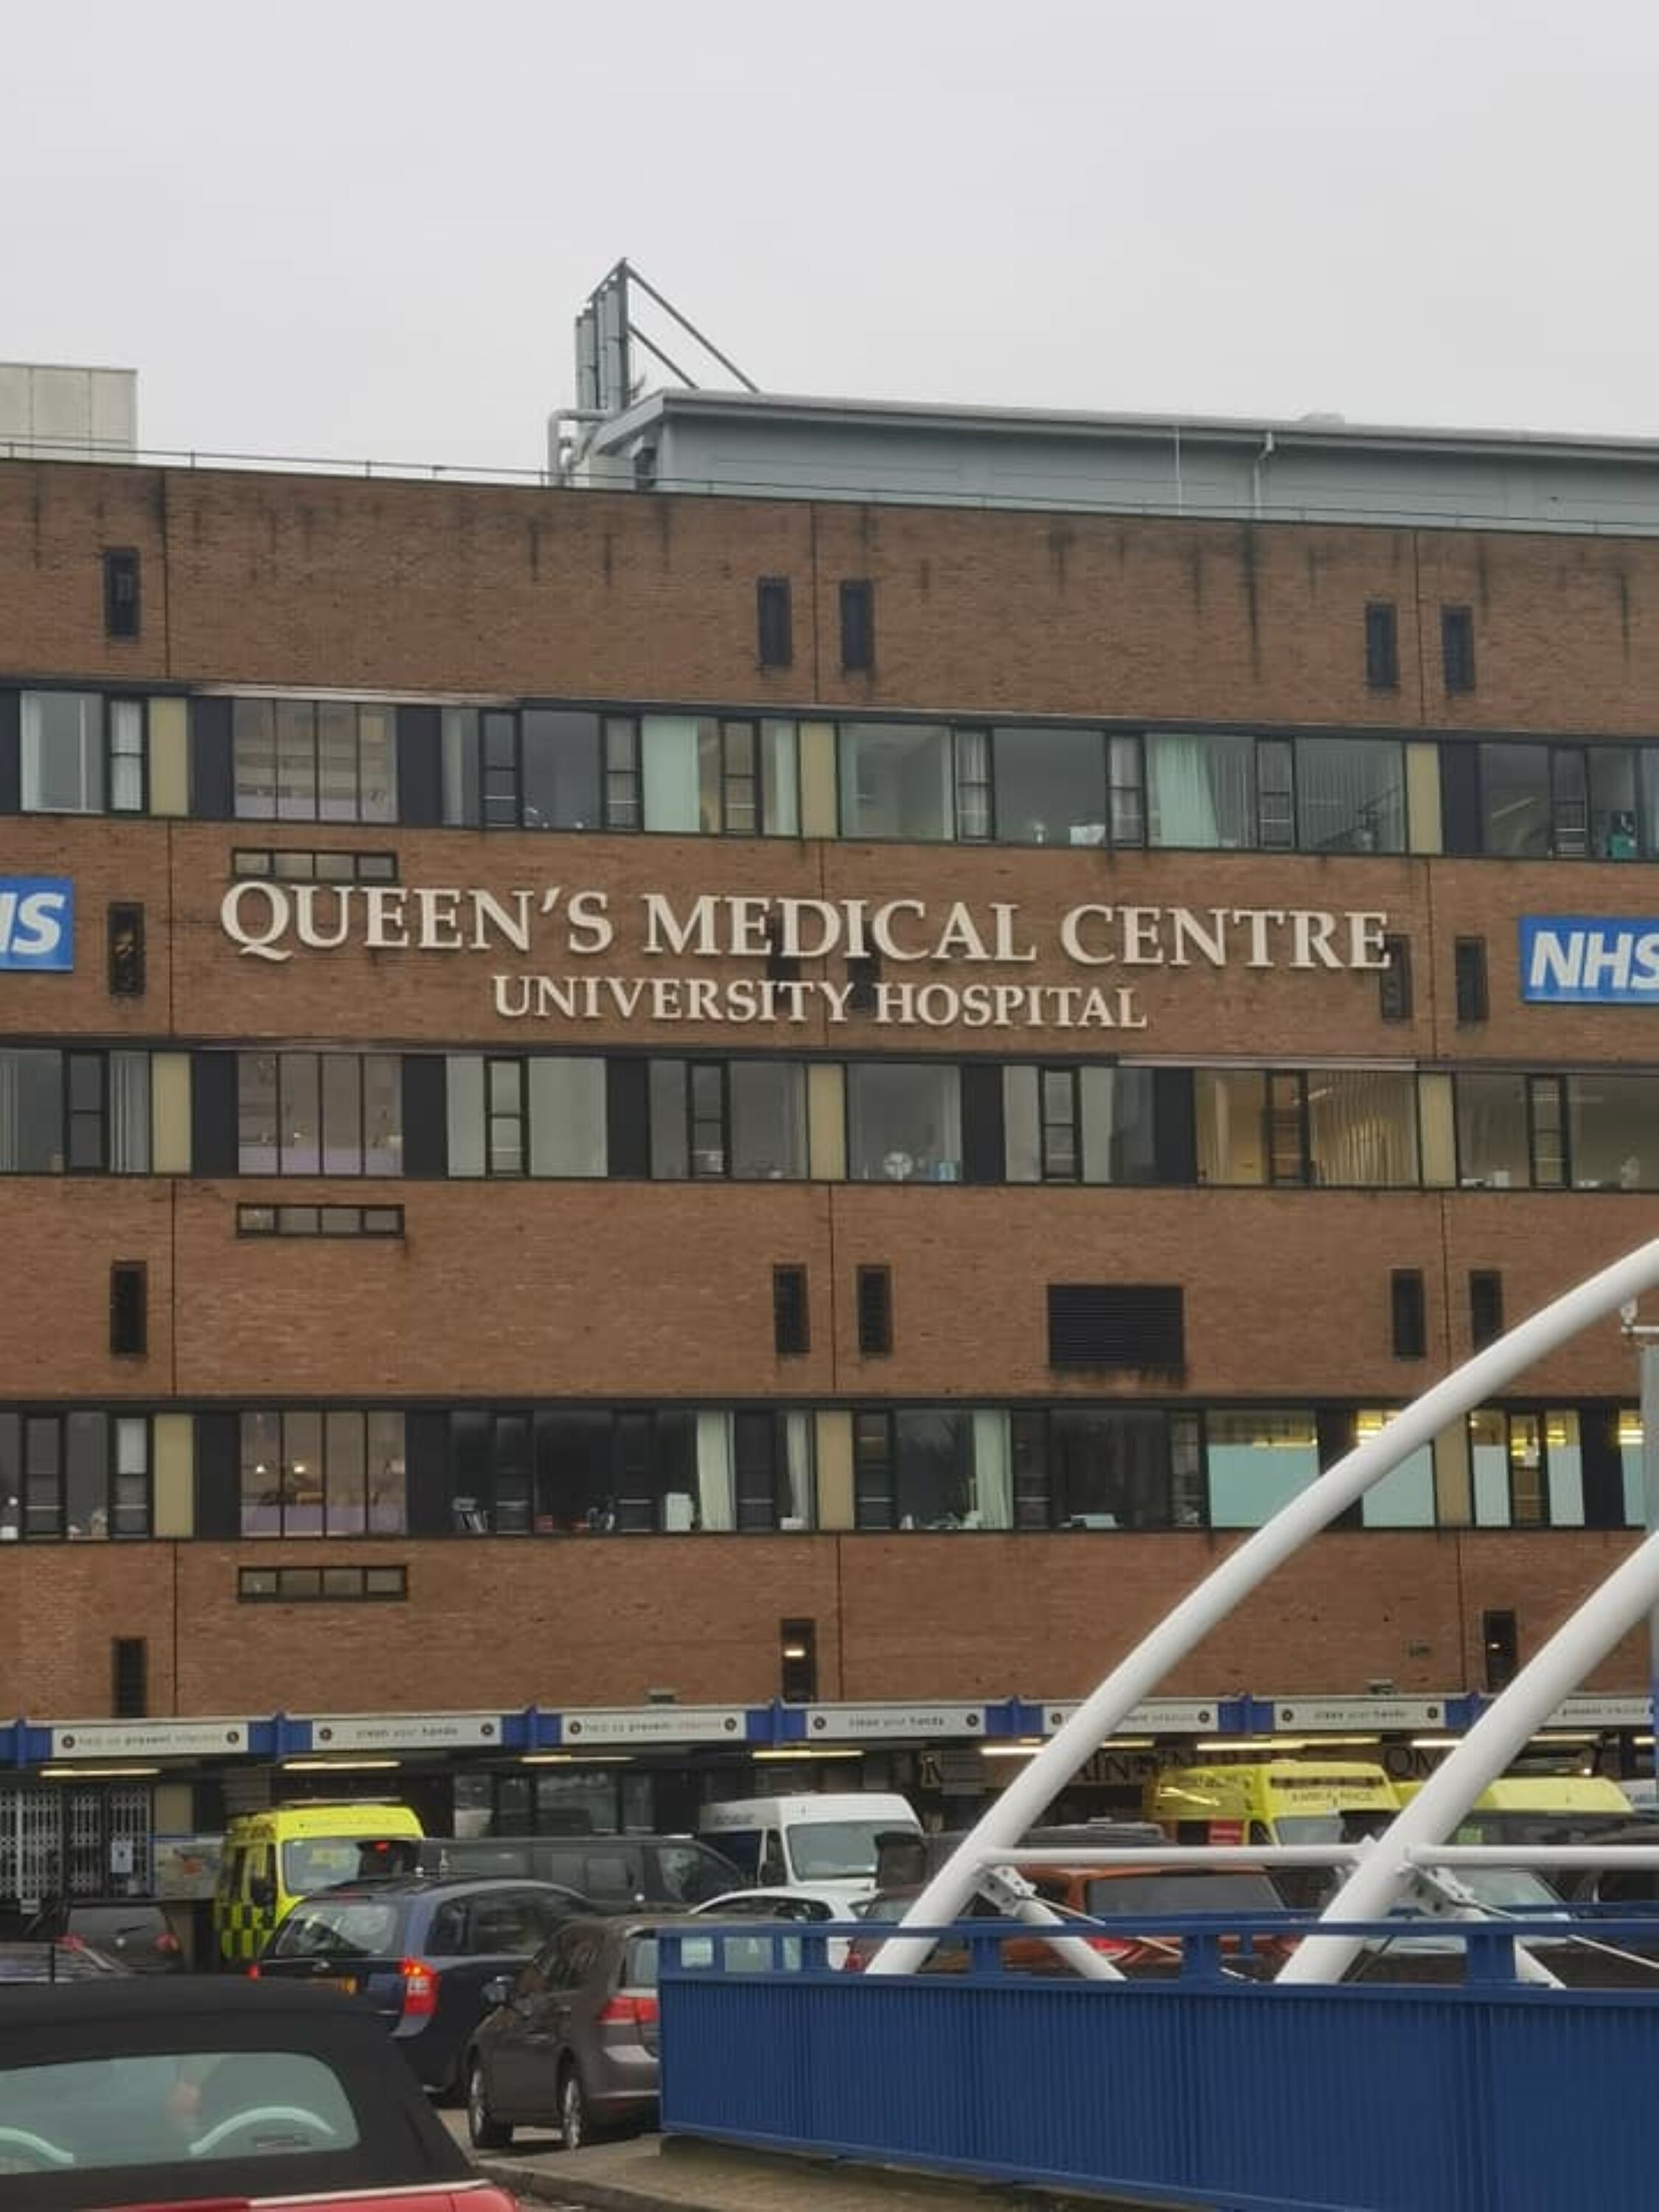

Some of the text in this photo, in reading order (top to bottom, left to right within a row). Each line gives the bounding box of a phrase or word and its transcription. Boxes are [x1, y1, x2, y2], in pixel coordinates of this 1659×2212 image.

[640, 892, 1038, 962] MEDICAL
[1059, 903, 1394, 970] CENTRE
[1528, 931, 1659, 989] NHS
[493, 975, 1149, 1030] UNIVERSITY HOSPITAL
